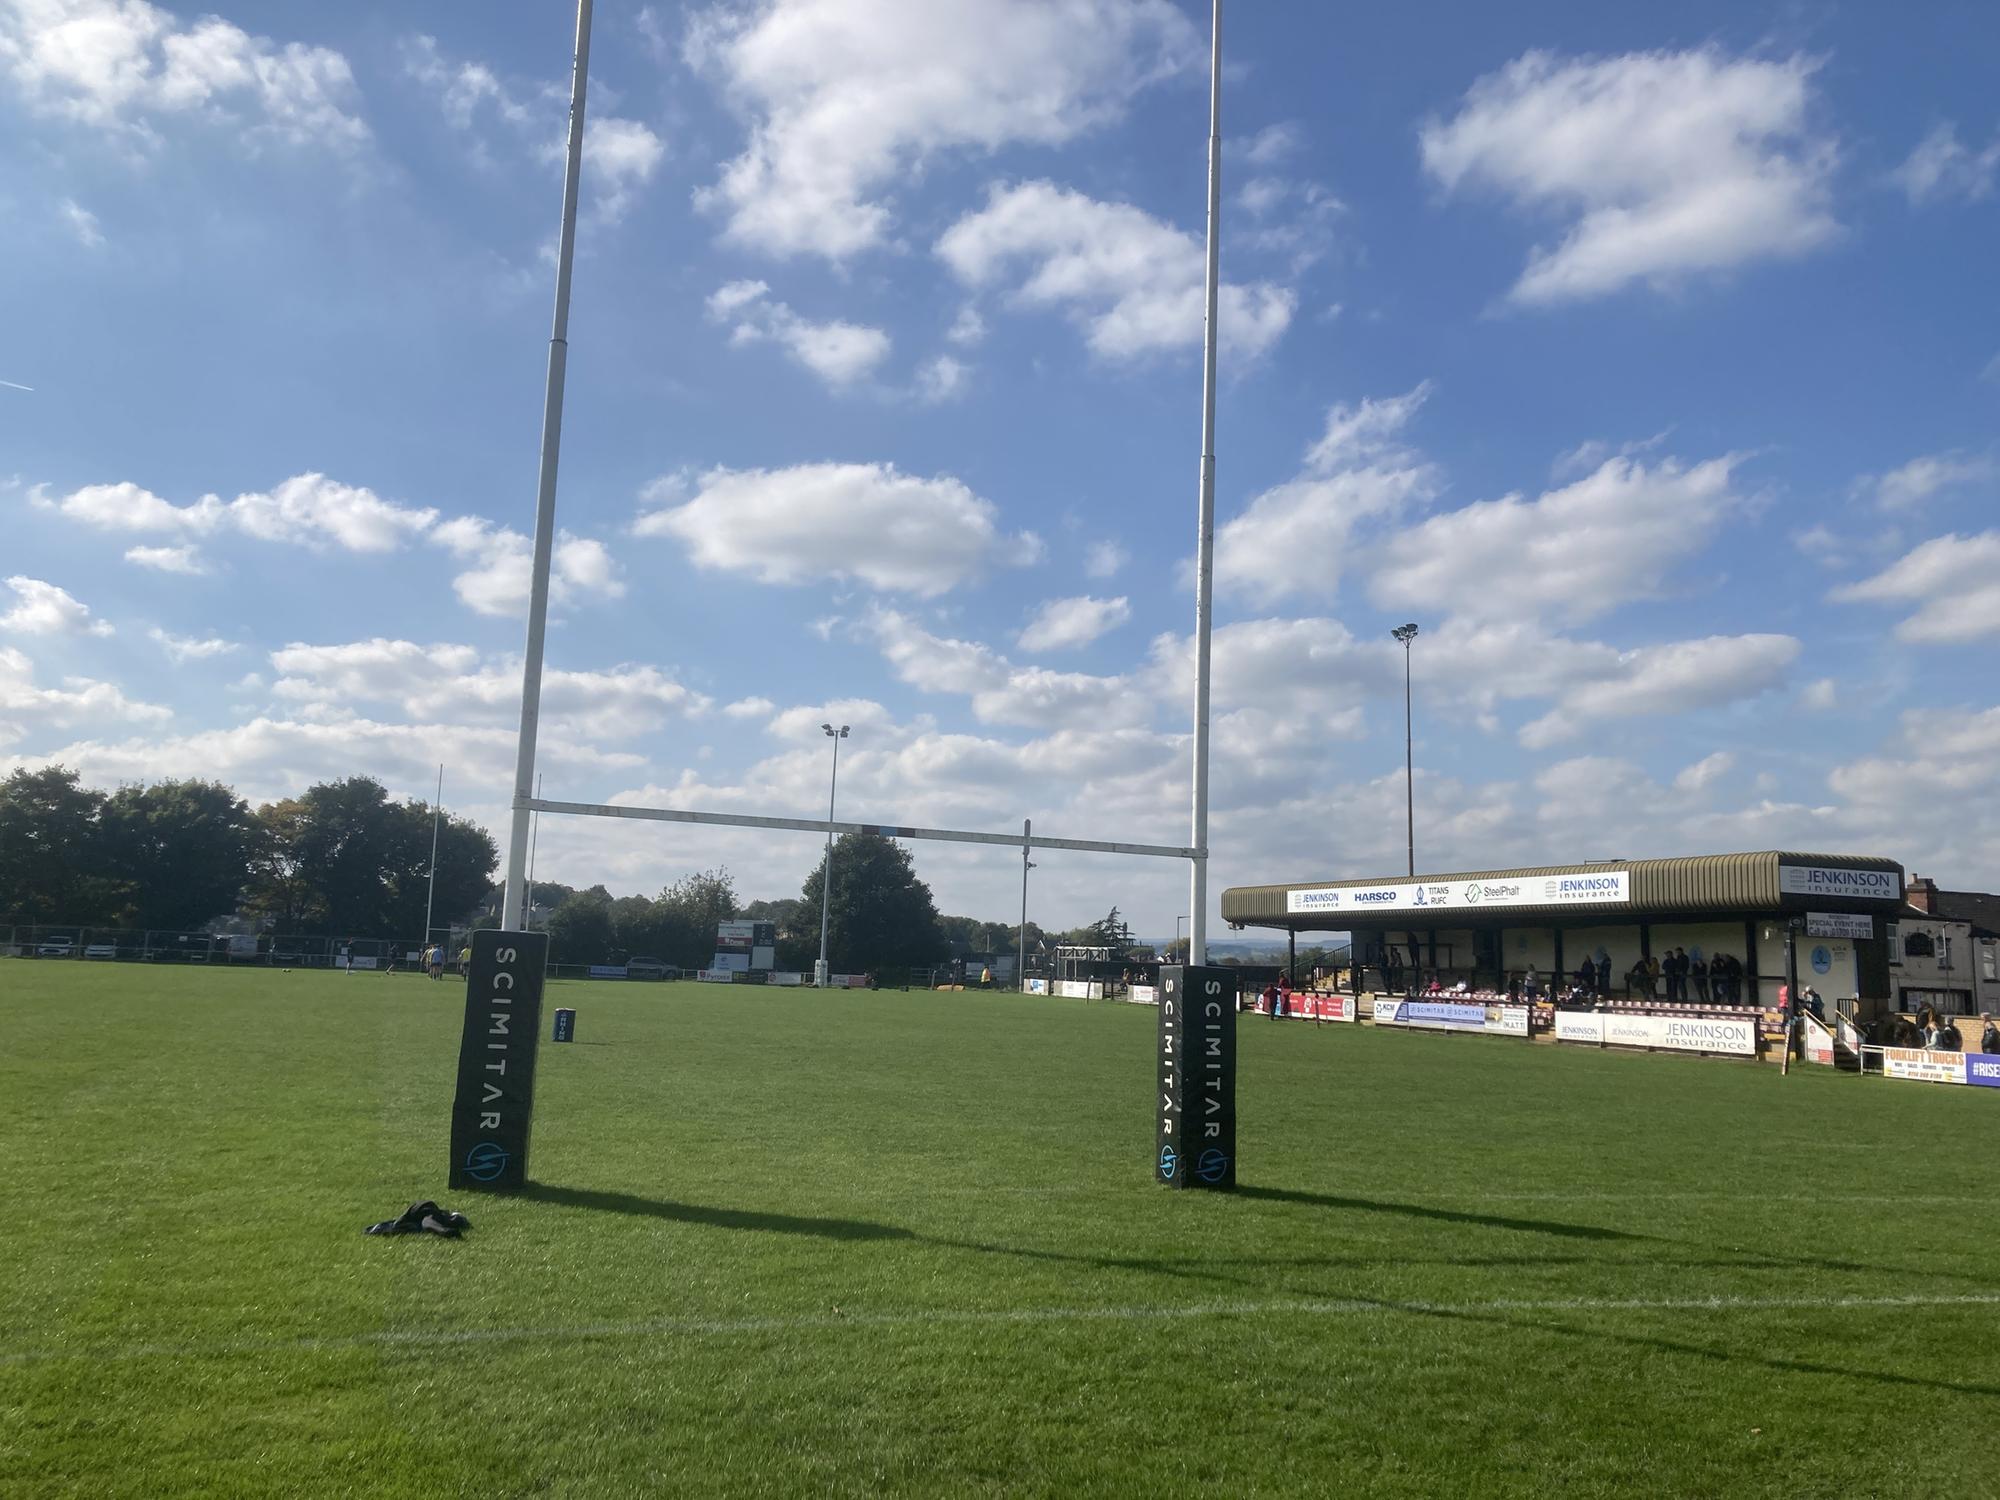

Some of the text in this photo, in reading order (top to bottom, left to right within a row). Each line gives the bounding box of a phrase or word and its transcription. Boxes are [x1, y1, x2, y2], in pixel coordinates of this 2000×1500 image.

[1807, 870, 1890, 887] JENKINSON
[1428, 886, 1449, 895] TITANS
[1484, 885, 1520, 896] SteelPhalt
[1559, 878, 1620, 892] JENKINSON
[1354, 892, 1396, 901] HARSCO
[1559, 890, 1620, 898] insurance
[1808, 886, 1891, 896] insurance
[1303, 893, 1339, 903] JENKINSON
[1430, 896, 1447, 904] RUFC
[1562, 1026, 1598, 1035] JENKINSON
[1612, 1028, 1649, 1038] JENKINSON
[1666, 1023, 1746, 1040] JENKINSON
[479, 947, 517, 1129] SCIMITAR
[1666, 1038, 1747, 1050] insurance
[1163, 978, 1174, 1134] SCIMITAR
[1204, 980, 1222, 1138] SCIMITAR
[1886, 1049, 1964, 1066] FORKLIFT TRUCKS
